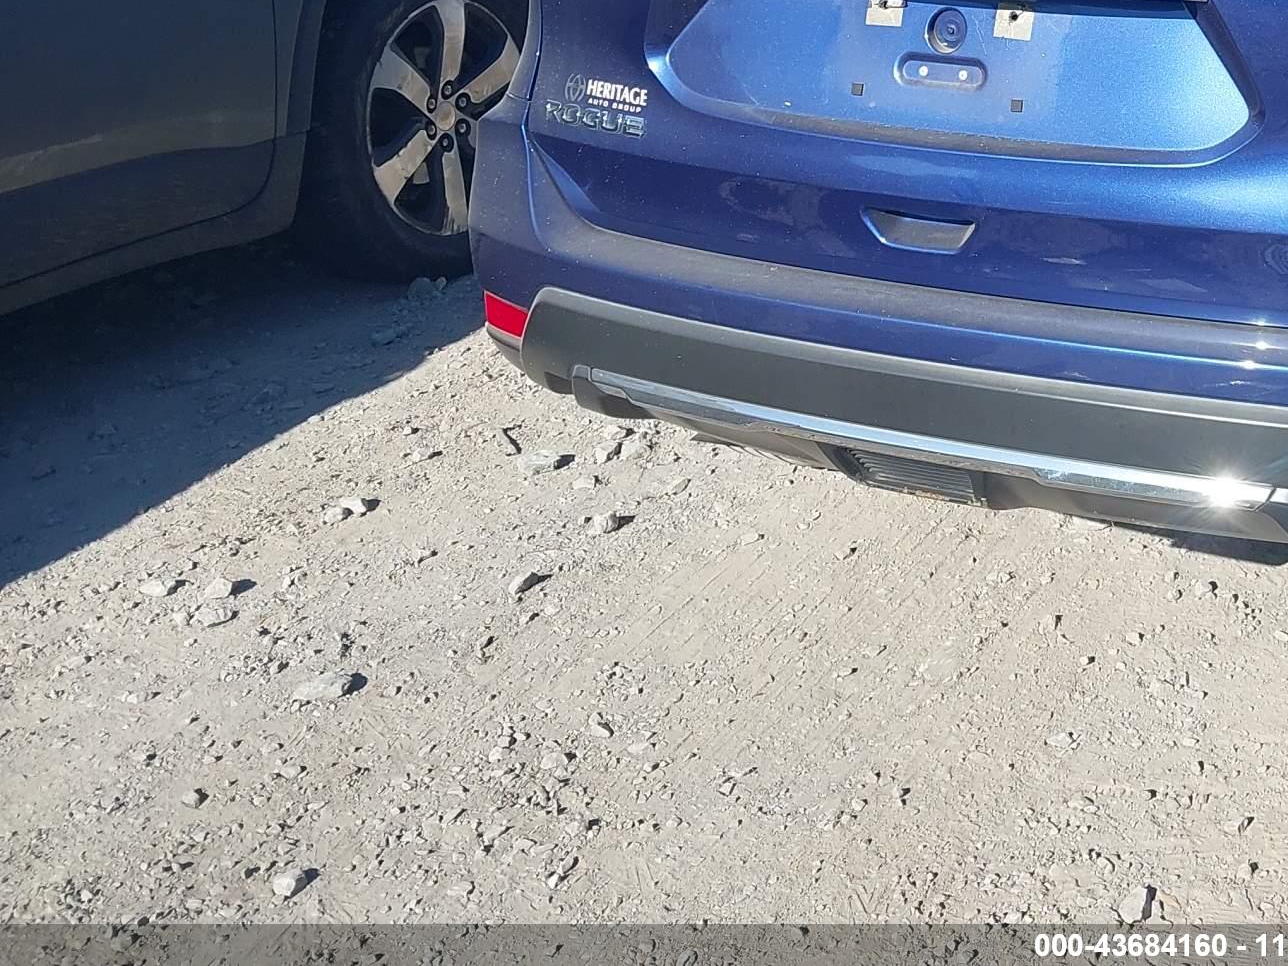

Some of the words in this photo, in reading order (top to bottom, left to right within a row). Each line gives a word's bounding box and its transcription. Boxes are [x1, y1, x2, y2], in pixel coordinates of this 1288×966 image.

[586, 79, 648, 106] HERITAGE
[587, 98, 609, 108] AUTO
[612, 103, 642, 113] GROUP
[545, 99, 647, 139] ROGUE
